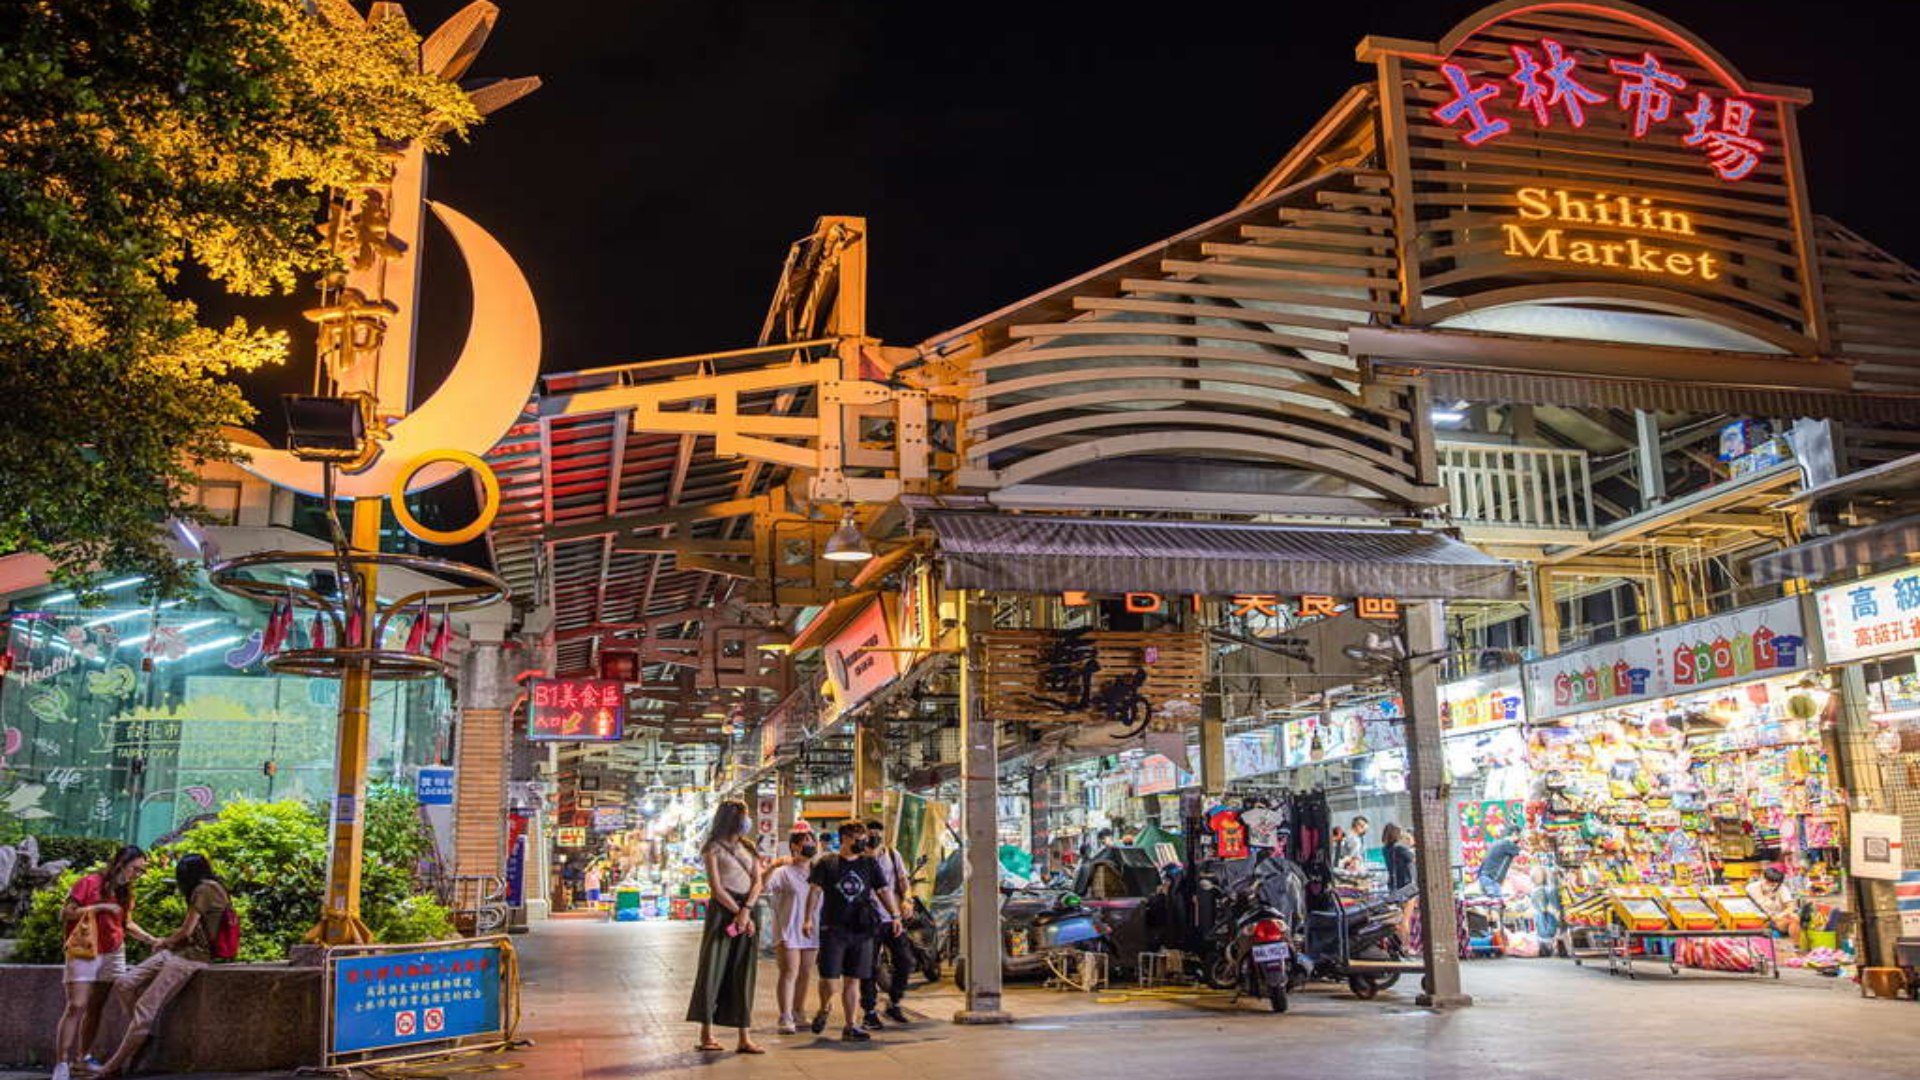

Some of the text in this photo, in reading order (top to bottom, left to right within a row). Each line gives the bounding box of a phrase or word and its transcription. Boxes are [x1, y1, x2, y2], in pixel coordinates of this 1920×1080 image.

[1433, 37, 1765, 181] 士林市場
[1515, 187, 1696, 237] Shilin
[1503, 224, 1719, 279] Market
[1675, 636, 1771, 682] Sport
[535, 682, 620, 708] B1美食區
